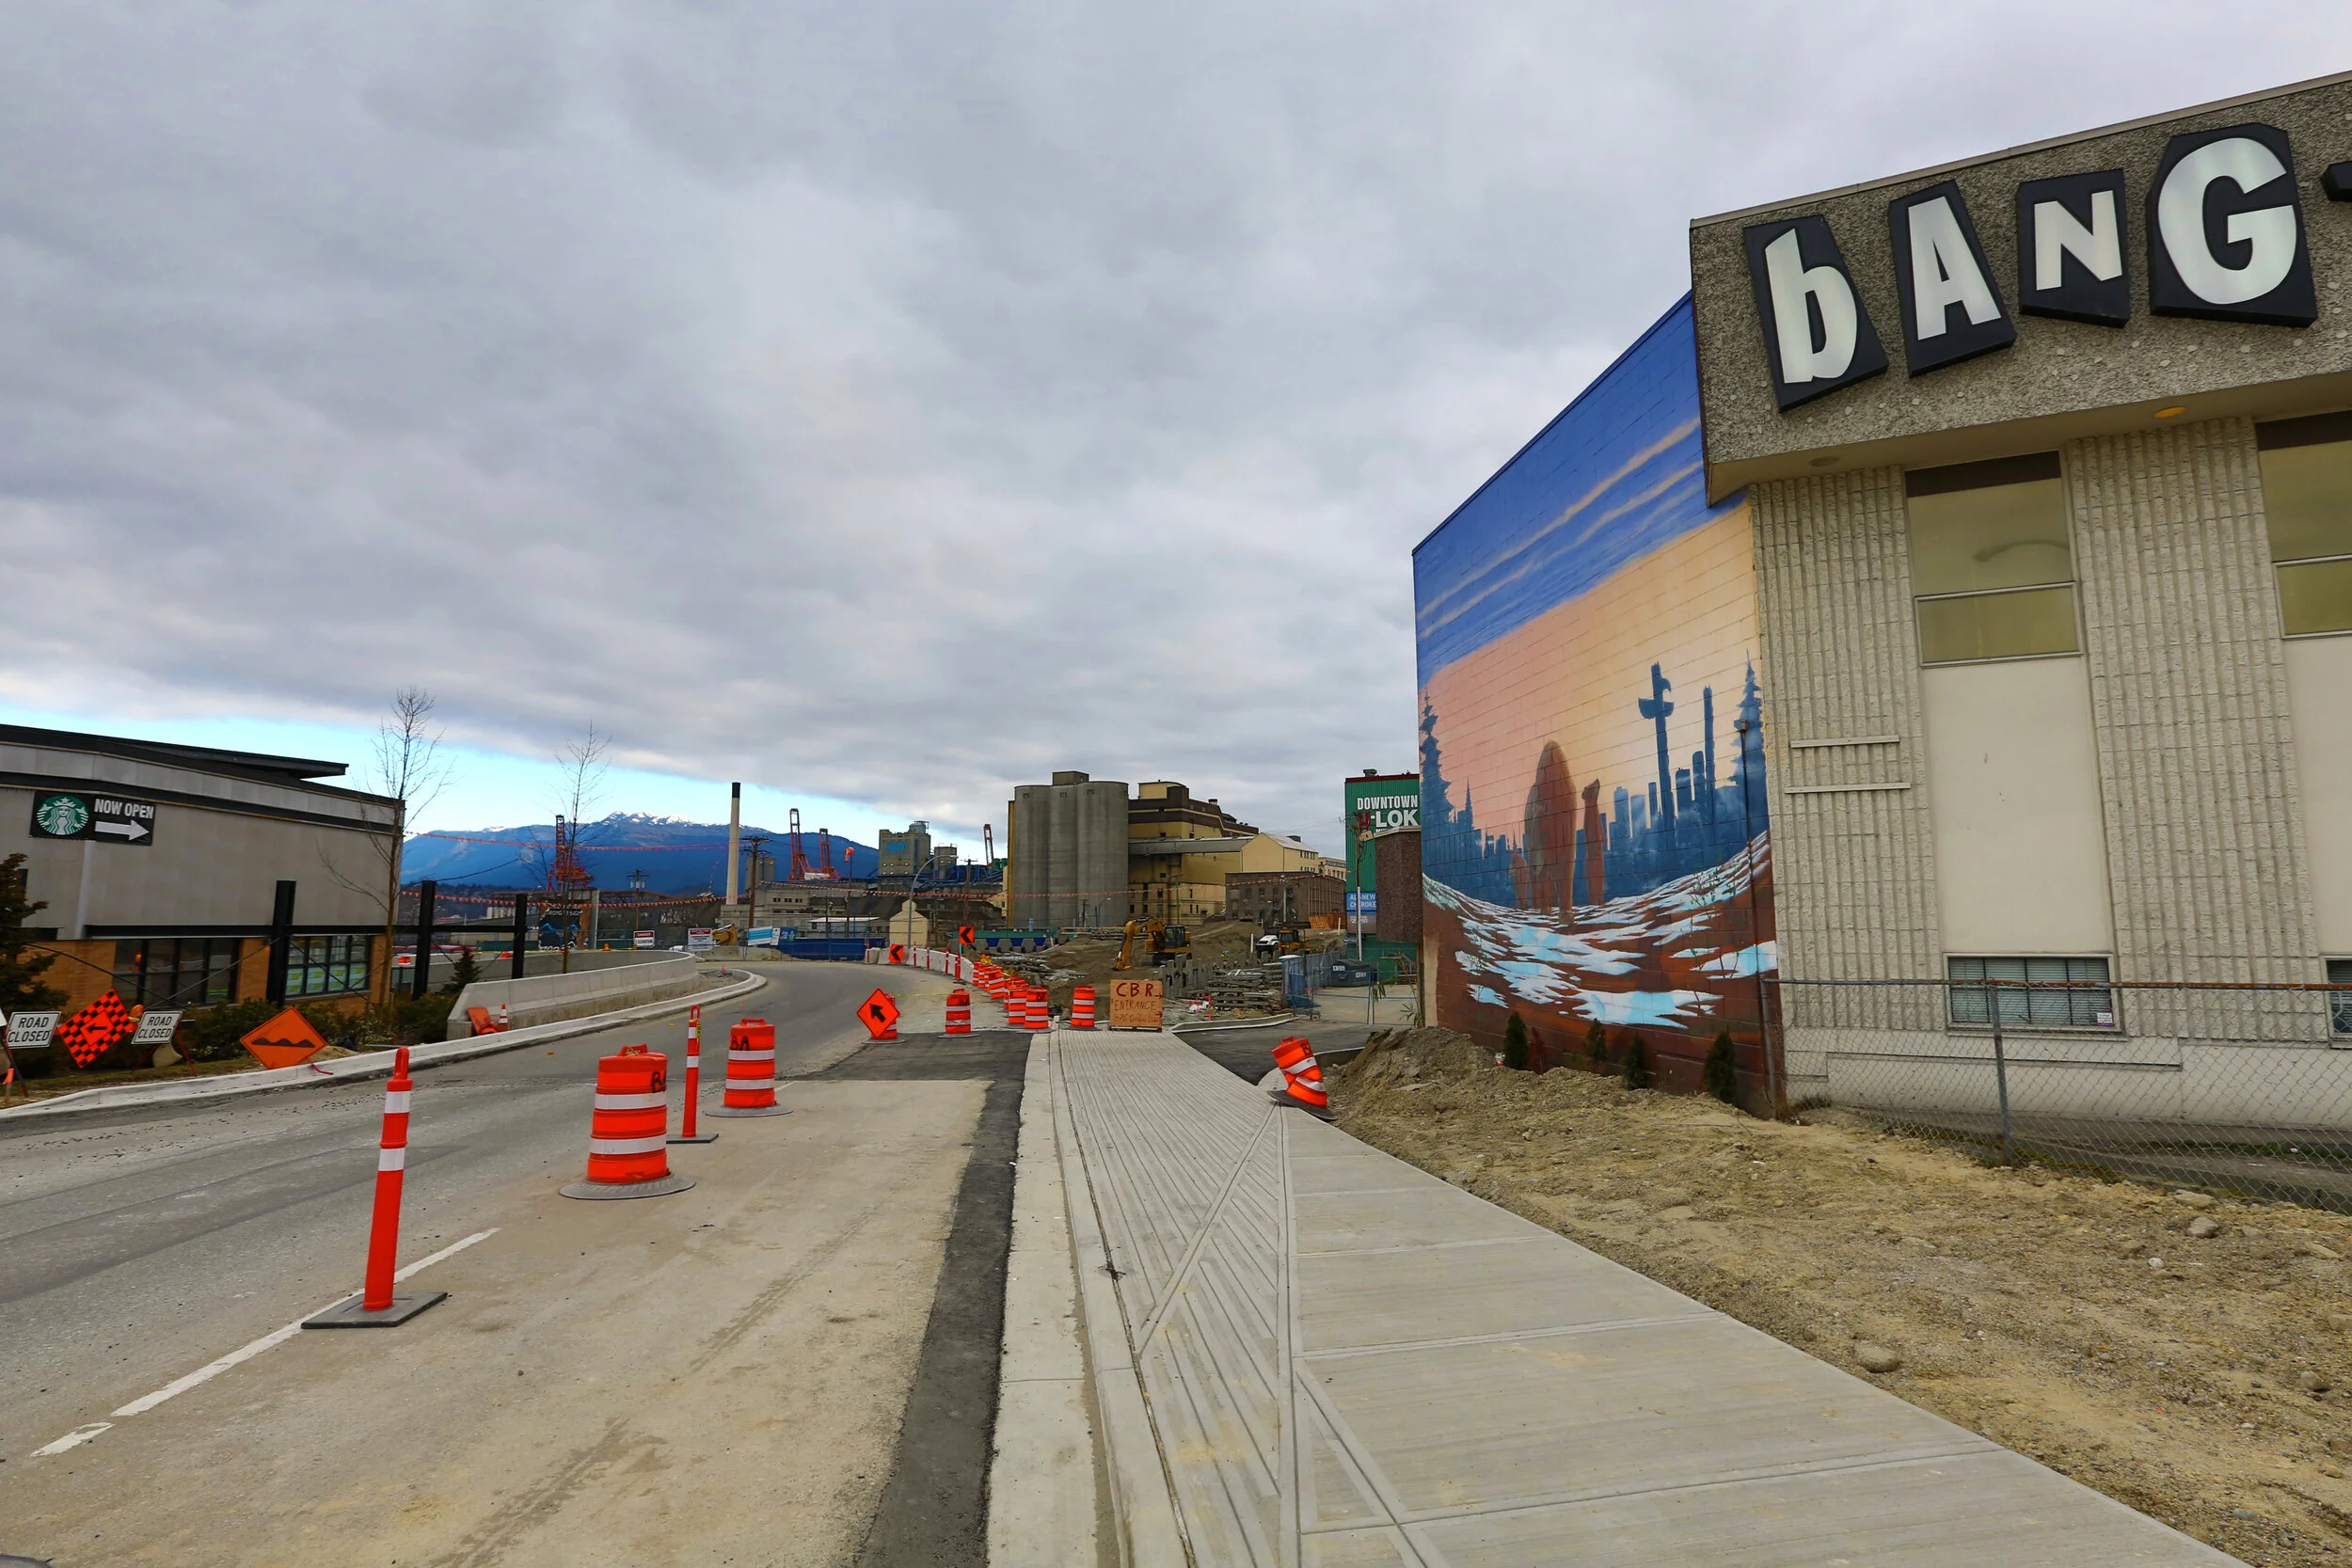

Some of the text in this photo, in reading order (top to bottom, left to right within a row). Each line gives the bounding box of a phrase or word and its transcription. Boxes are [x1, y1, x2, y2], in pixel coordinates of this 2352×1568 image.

[1357, 795, 1418, 810] DOWNTOWN
[94, 799, 154, 819] NOW OPEN
[1114, 999, 1156, 1011] ENTRANCE
[18, 1017, 49, 1028] ROAD
[147, 1016, 172, 1026] ROAD
[8, 1030, 51, 1043] CLOSED
[137, 1028, 172, 1038] CLOSED
